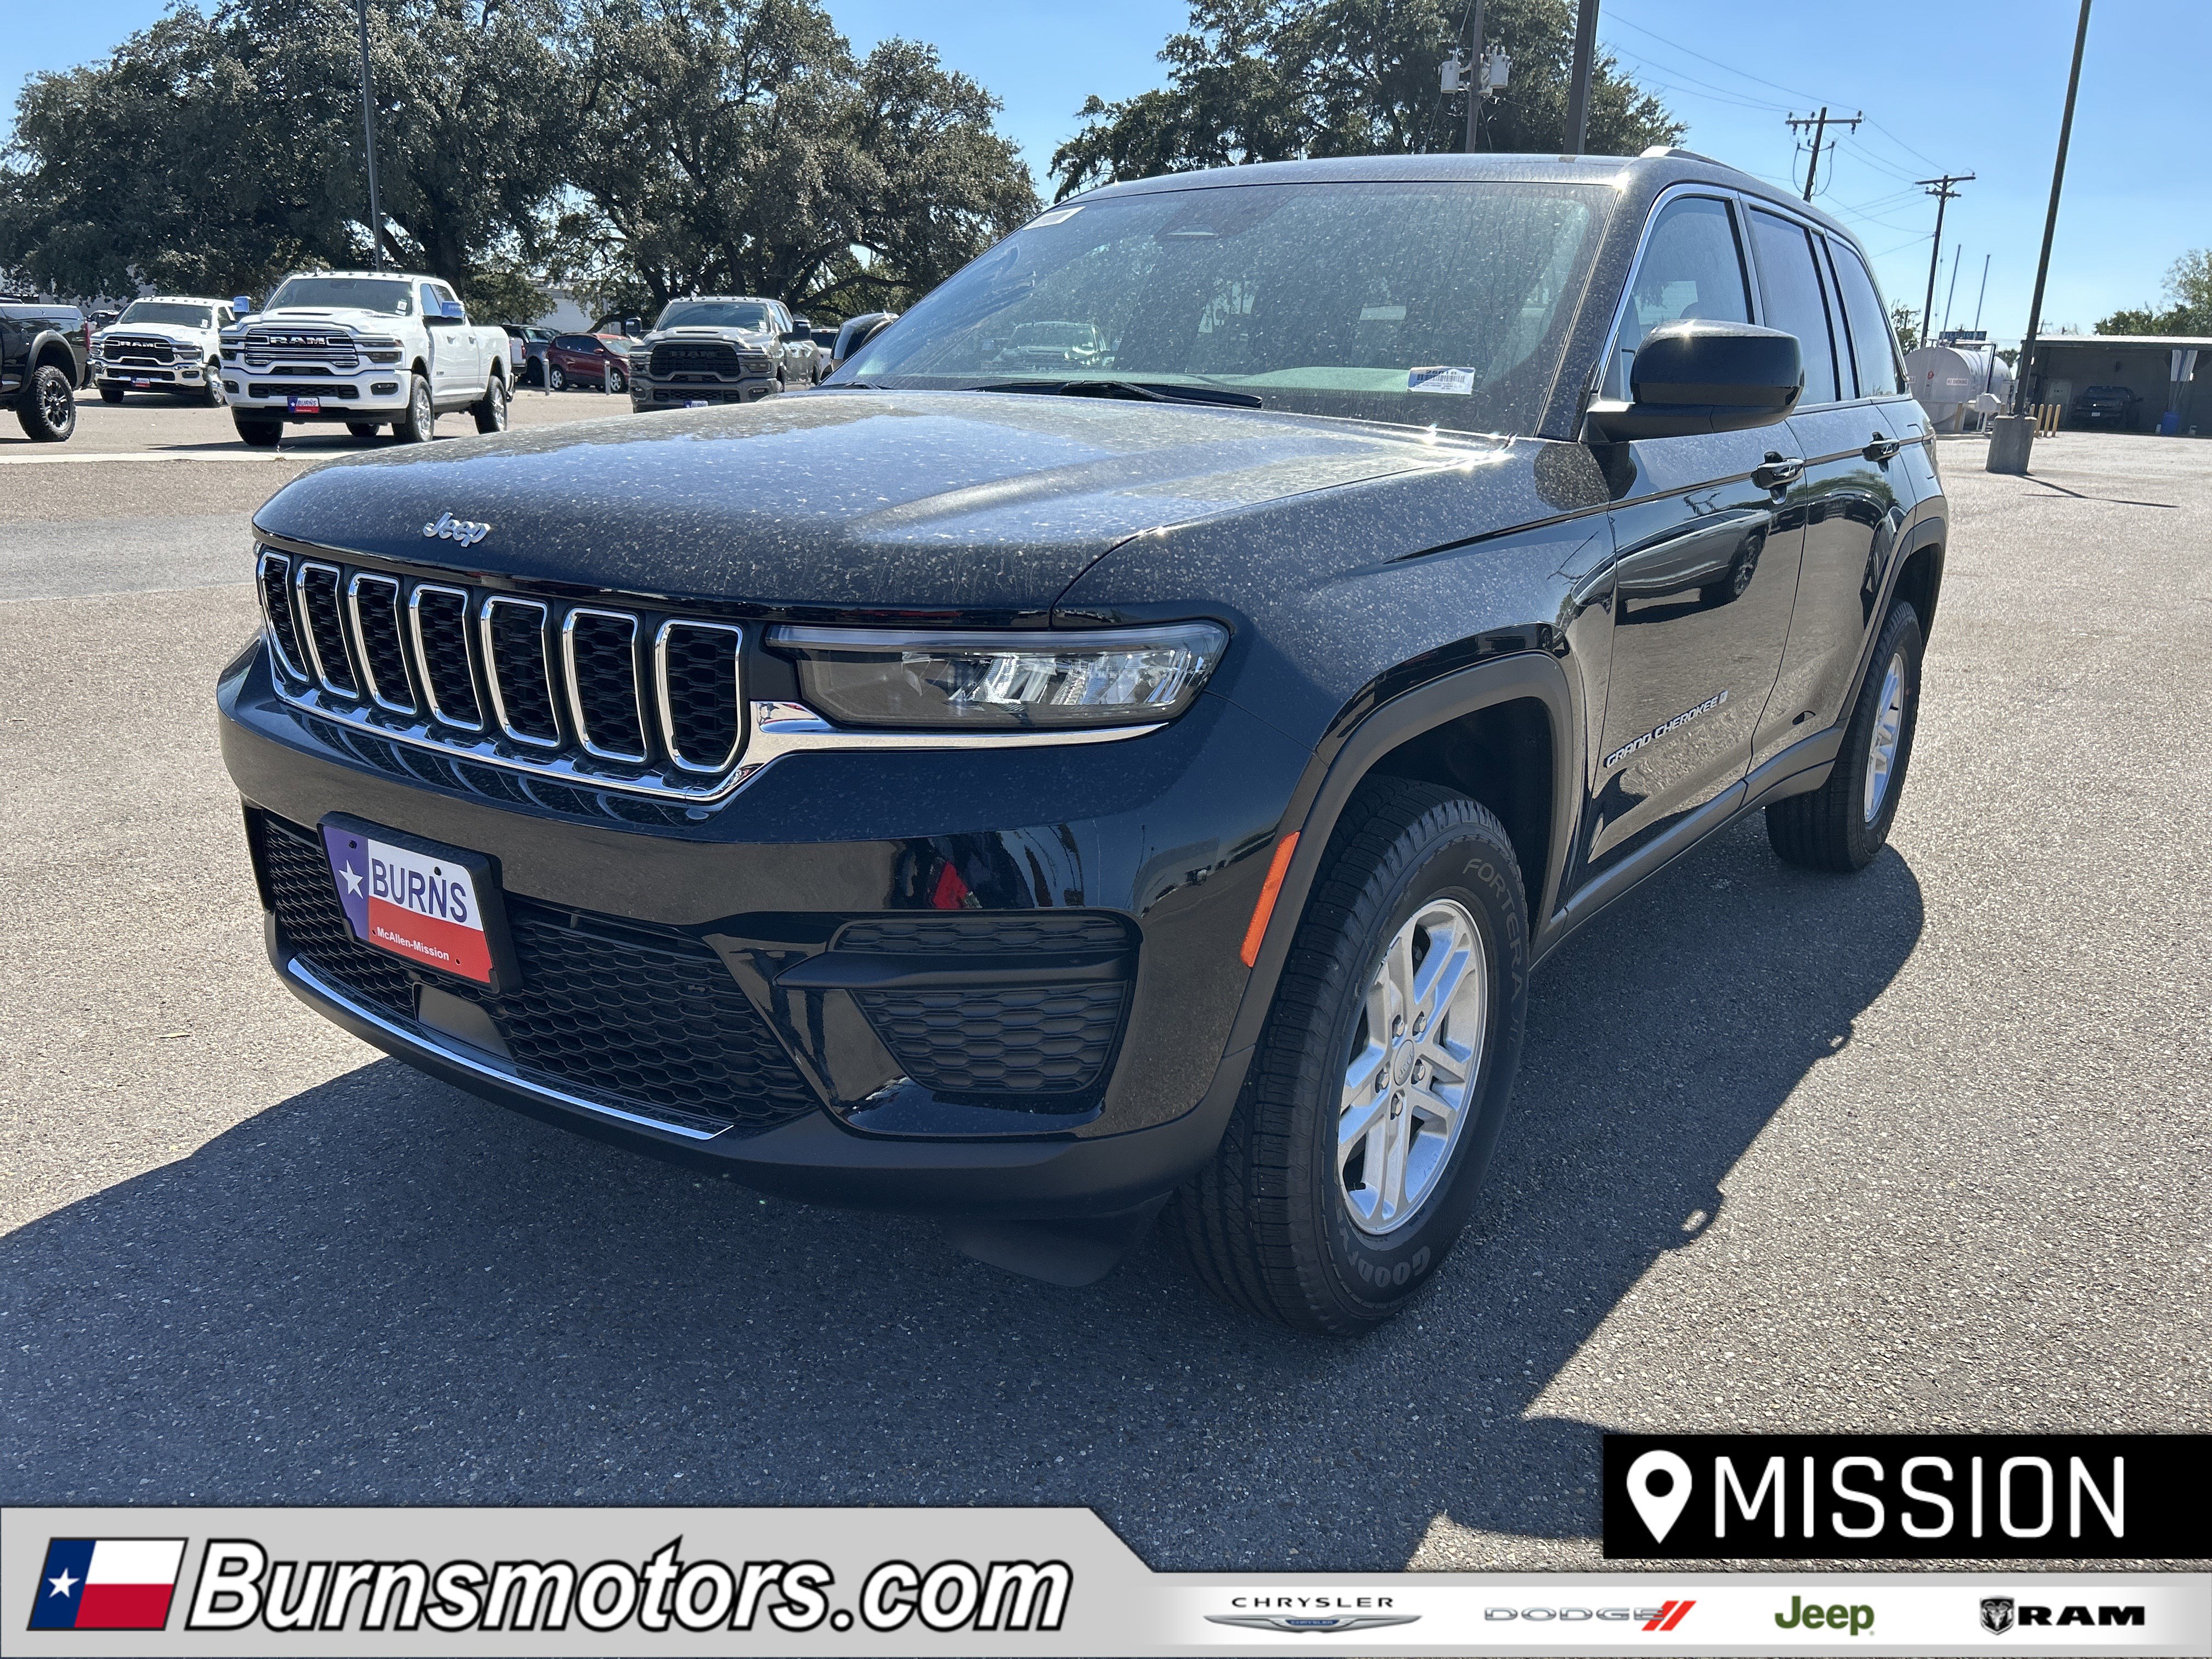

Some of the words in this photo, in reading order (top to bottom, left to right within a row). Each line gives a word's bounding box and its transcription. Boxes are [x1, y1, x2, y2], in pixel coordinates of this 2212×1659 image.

[270, 336, 325, 345] RAM
[671, 350, 717, 358] RAM
[423, 511, 491, 548] Jeep
[1605, 731, 1652, 769] GRAND
[1652, 695, 1718, 740] CHEROKEE
[371, 858, 468, 923] BURNS
[377, 926, 449, 961] McAllen-Mission
